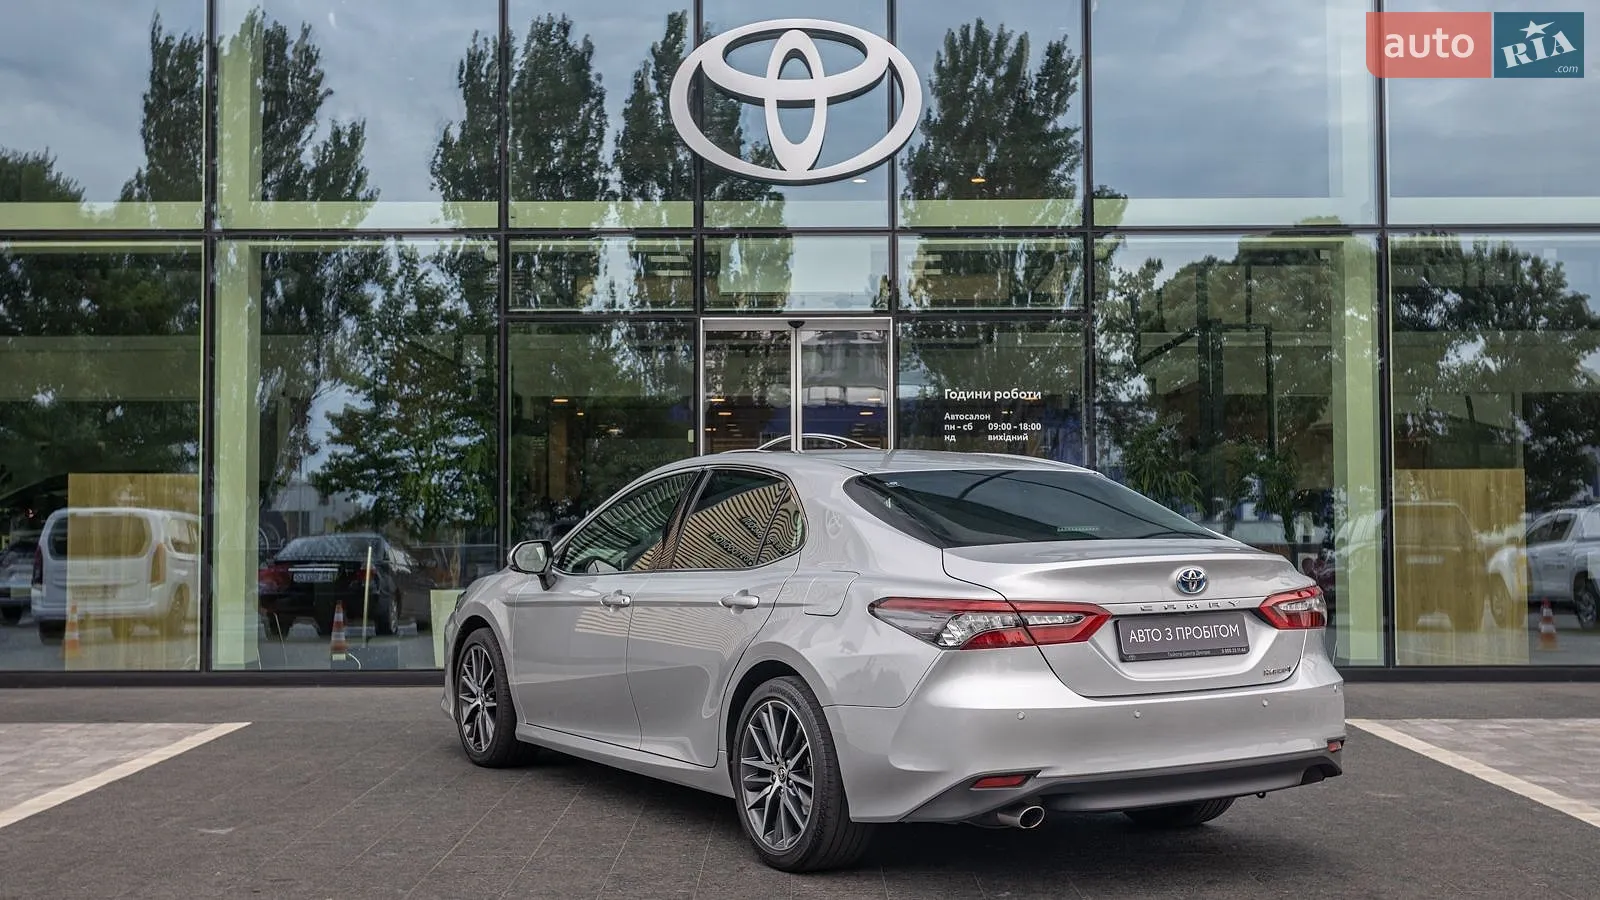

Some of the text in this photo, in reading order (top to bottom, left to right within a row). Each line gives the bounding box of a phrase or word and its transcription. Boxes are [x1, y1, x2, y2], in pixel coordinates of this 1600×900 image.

[944, 387, 1042, 402] Години роботи
[944, 412, 991, 421] Автосалон
[962, 422, 973, 431] сб
[988, 423, 1012, 431] 09:00
[1019, 422, 1042, 431] 18:00
[944, 433, 1029, 442] нд вихідний
[1140, 599, 1239, 611] CAMRY
[1129, 628, 1162, 643] АВТО
[1175, 623, 1240, 641] ПРОБІГОМ
